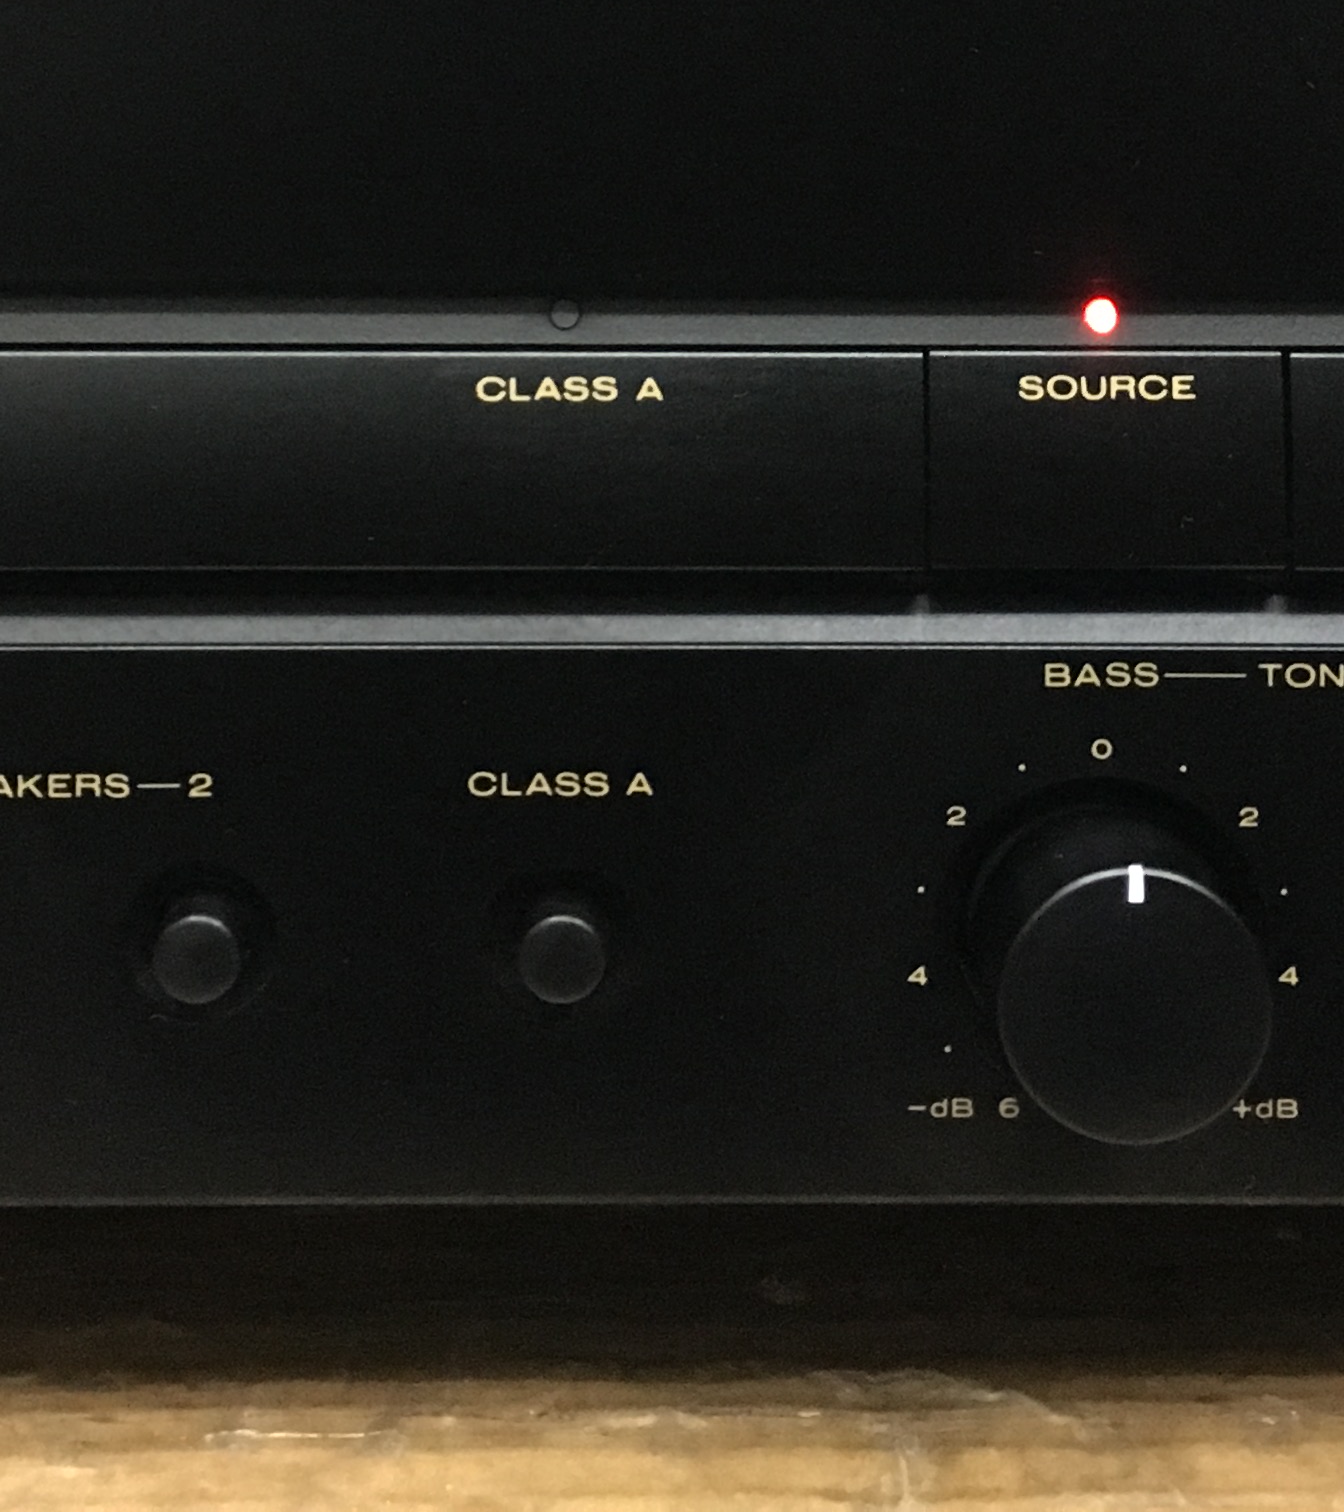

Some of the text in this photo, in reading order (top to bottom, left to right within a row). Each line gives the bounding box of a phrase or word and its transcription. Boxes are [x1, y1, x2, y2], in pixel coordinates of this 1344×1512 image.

[474, 374, 665, 404] CLASS A
[1017, 373, 1198, 402] SOURCE
[466, 770, 655, 798] CLASS A
[945, 804, 968, 827] 2
[1237, 805, 1260, 829] 2
[906, 964, 929, 987] 4
[1277, 965, 1300, 987] 4
[997, 1096, 1021, 1120] 6
